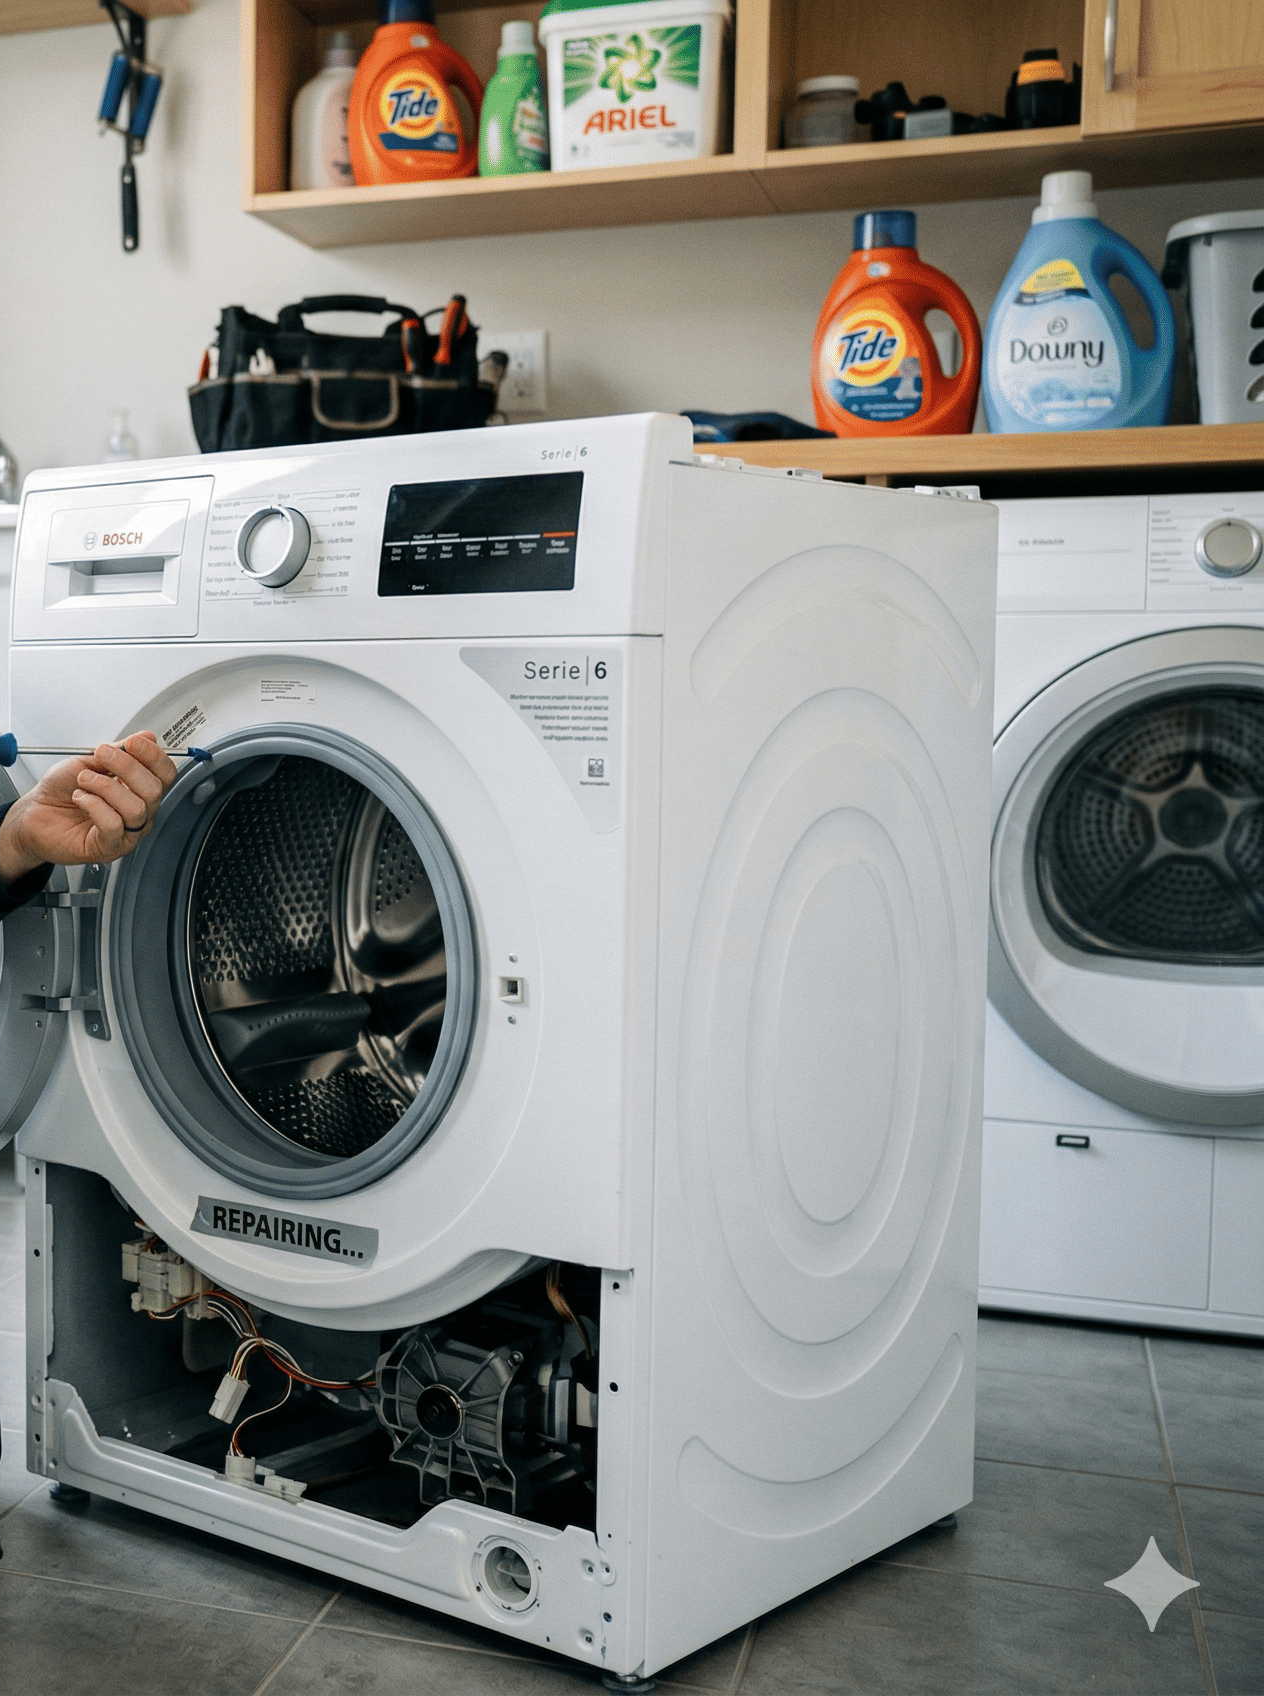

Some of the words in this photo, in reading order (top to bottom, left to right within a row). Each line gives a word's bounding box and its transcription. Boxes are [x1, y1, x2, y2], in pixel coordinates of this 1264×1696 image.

[389, 89, 439, 126] Tide
[583, 105, 676, 135] ARIEL
[840, 330, 897, 371] Tide
[1010, 339, 1104, 368] Downy
[102, 531, 143, 546] BOSCH
[213, 1205, 364, 1259] REPAIRING...
